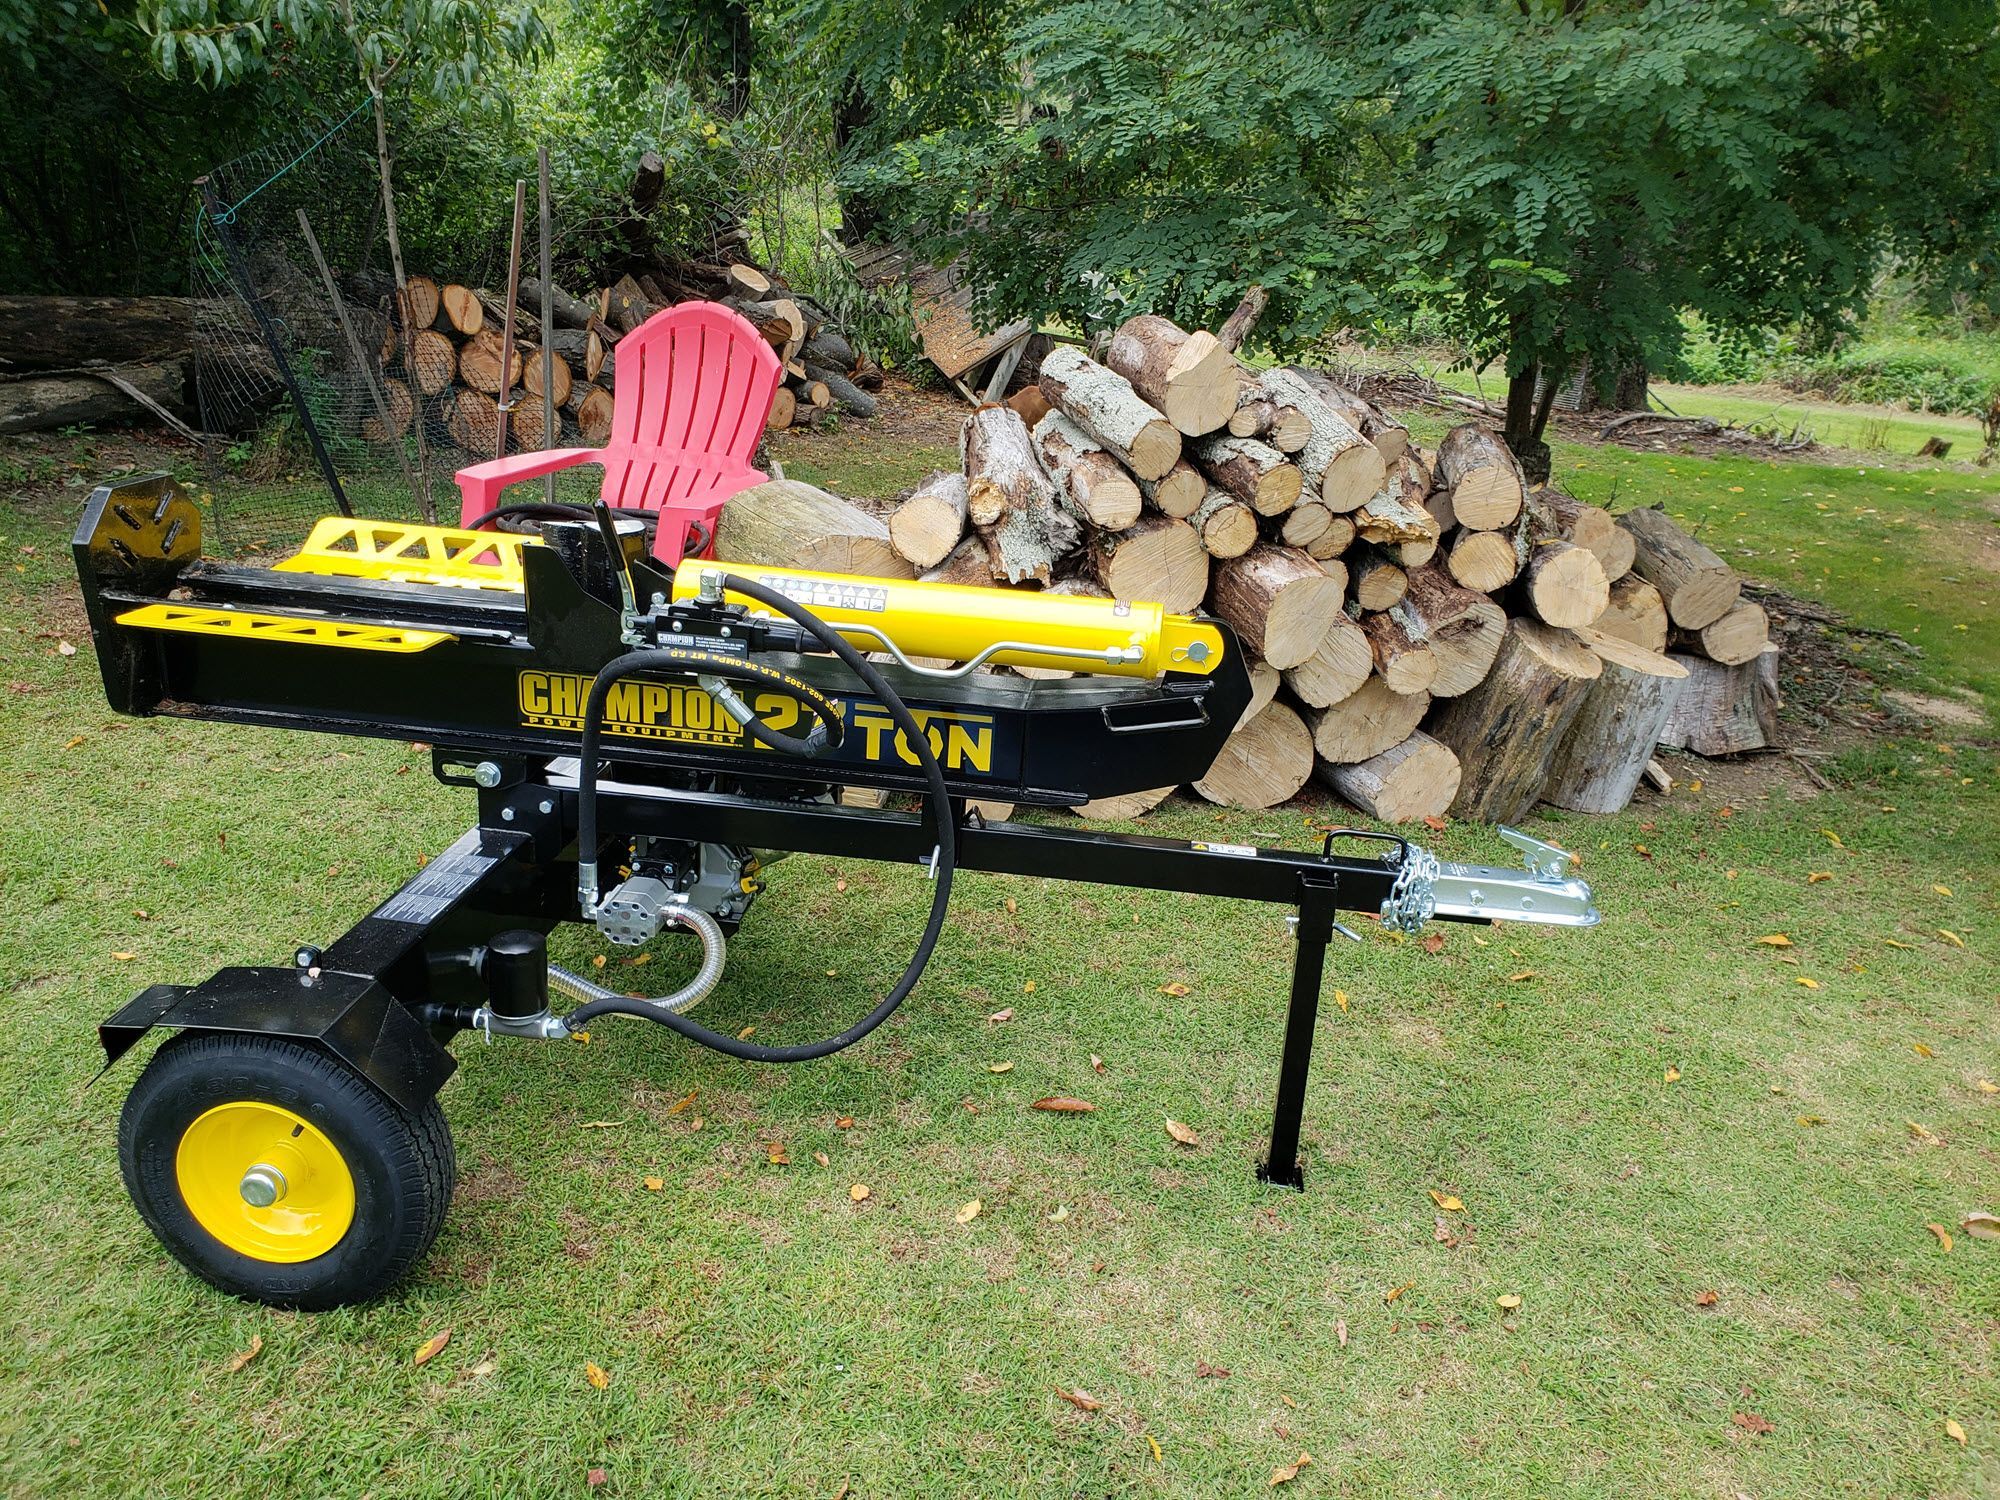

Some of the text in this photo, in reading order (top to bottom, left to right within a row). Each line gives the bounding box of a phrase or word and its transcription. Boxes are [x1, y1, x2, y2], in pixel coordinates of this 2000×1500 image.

[657, 633, 694, 645] CHAMPION
[530, 717, 737, 743] POWE EQUIPMENT
[854, 714, 992, 772] TON
